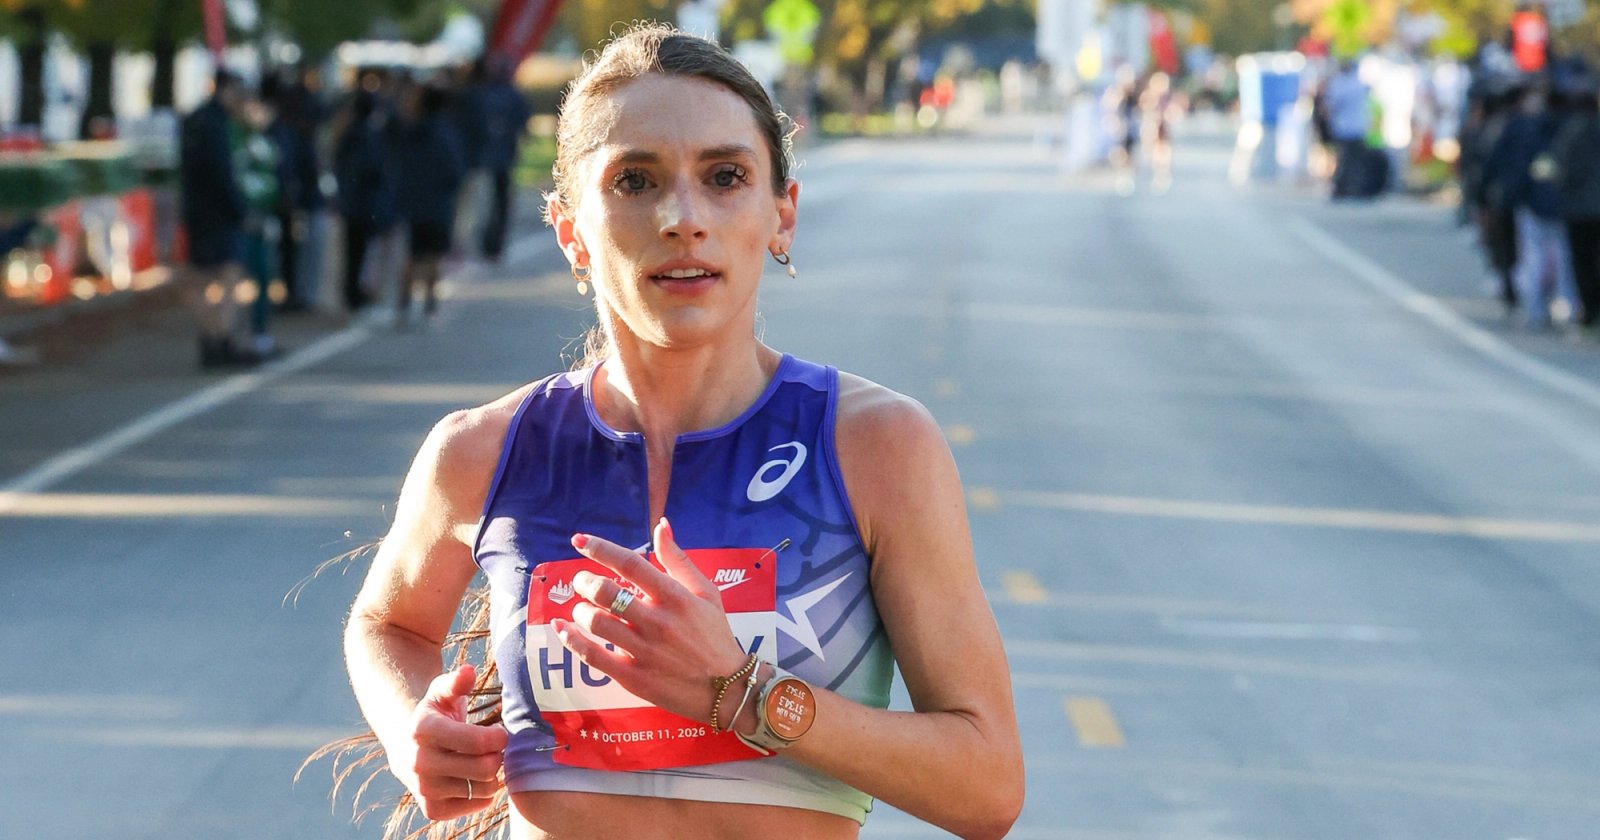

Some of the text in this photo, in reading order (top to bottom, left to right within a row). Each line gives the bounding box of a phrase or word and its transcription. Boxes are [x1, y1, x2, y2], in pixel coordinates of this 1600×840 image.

[714, 569, 746, 583] RUN
[602, 727, 706, 743] OCTOBER 11, 2026
